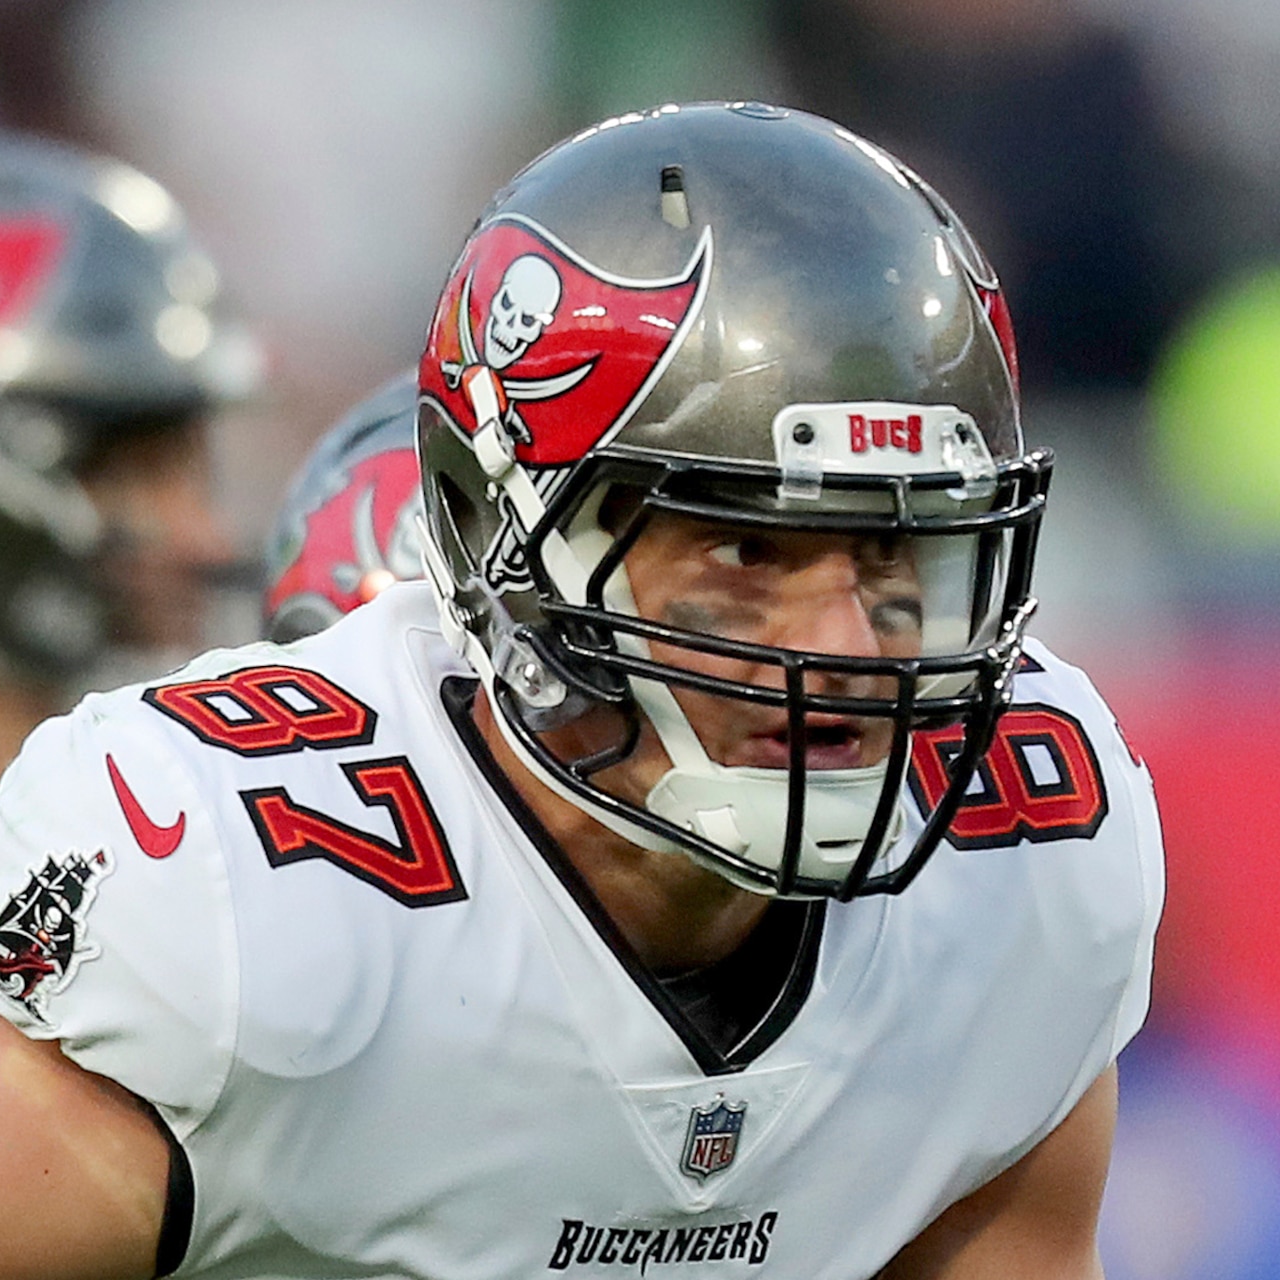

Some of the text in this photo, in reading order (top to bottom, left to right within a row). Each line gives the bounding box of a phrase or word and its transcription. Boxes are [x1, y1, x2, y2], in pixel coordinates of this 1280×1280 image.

[141, 664, 470, 910] 87
[691, 1136, 732, 1169] NFL
[548, 1211, 779, 1277] BUCCANEERS
